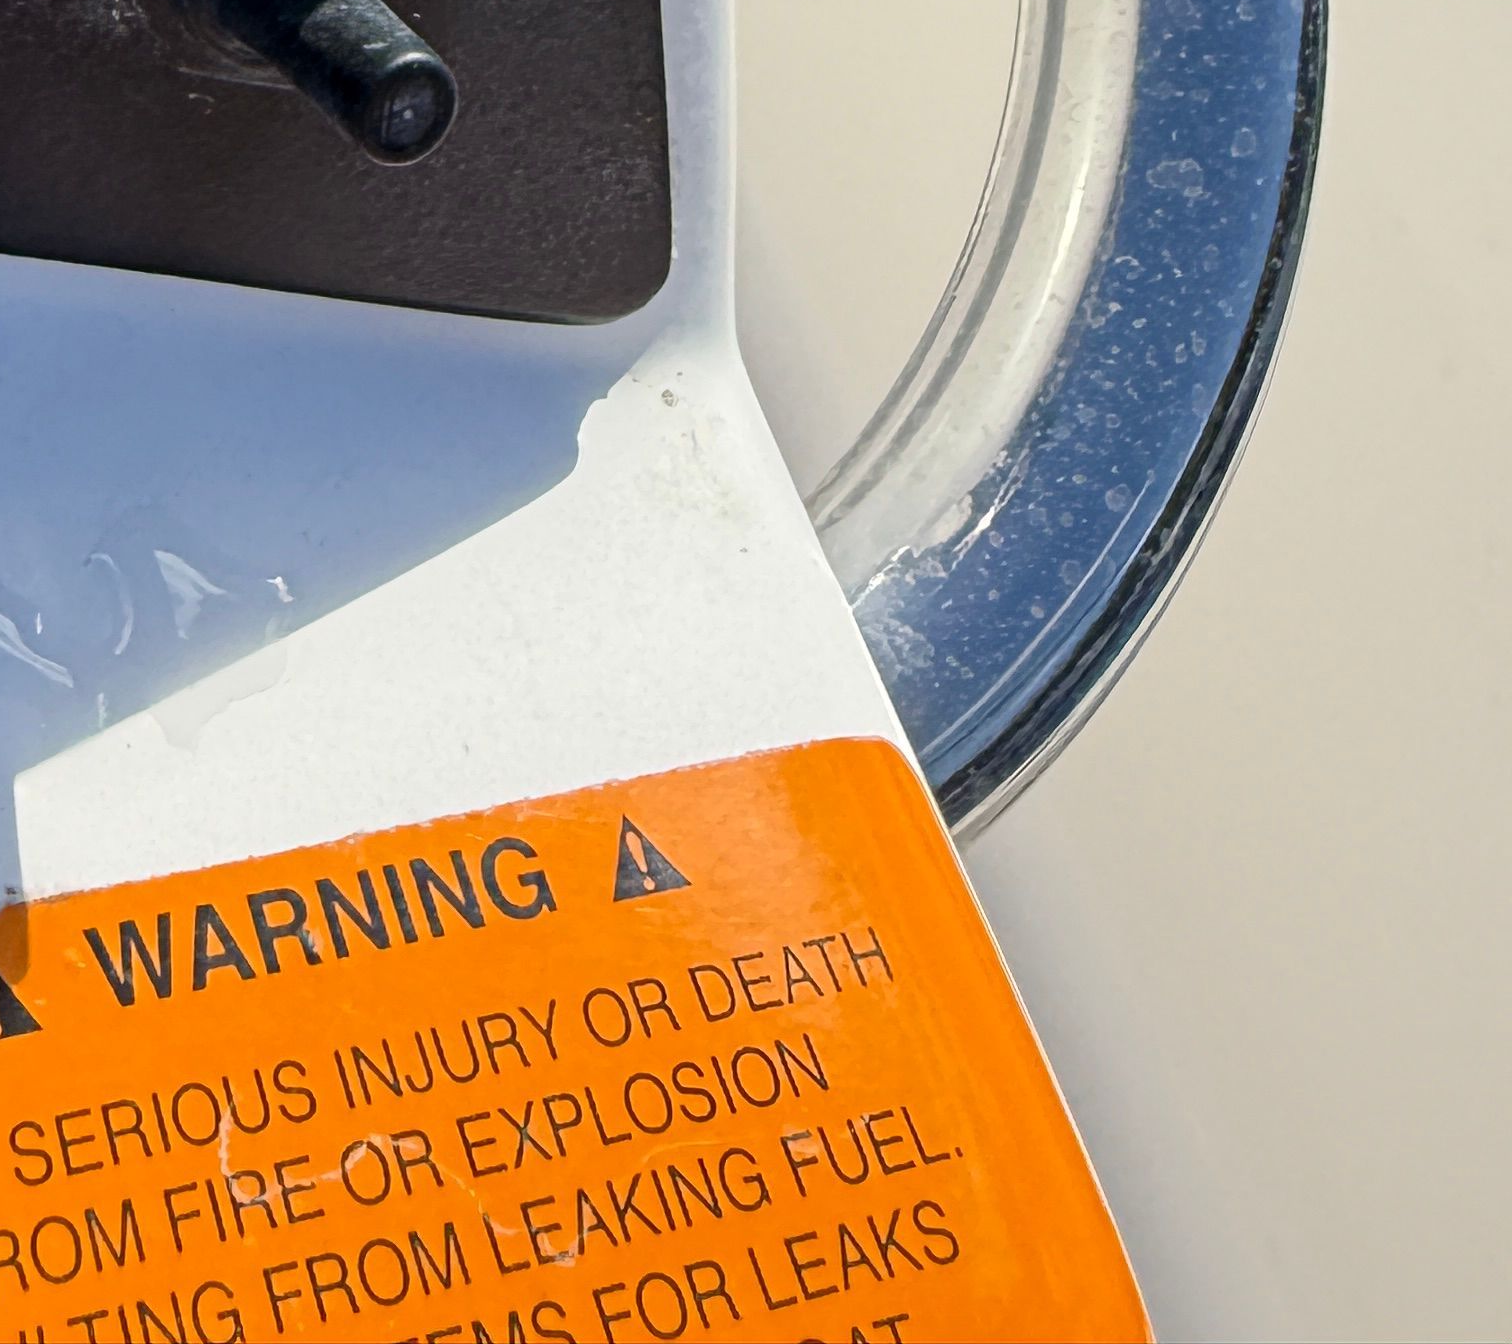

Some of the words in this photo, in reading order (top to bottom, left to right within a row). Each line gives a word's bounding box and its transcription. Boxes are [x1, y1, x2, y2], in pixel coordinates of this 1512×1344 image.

[82, 836, 558, 1008] WARNING
[8, 1059, 317, 1187] SERIOUS
[333, 998, 558, 1110] INJURY
[582, 978, 682, 1048] OR
[687, 926, 894, 1023] DEATH
[163, 1154, 326, 1254] FIRE
[340, 1129, 445, 1206] OR
[455, 1033, 830, 1178] EXPLOSION
[262, 1221, 472, 1335] FROM
[482, 1147, 772, 1275] LEAKING
[779, 1106, 964, 1198] FUEL.
[591, 1259, 741, 1344] FOR
[747, 1199, 960, 1311] LEAKS
